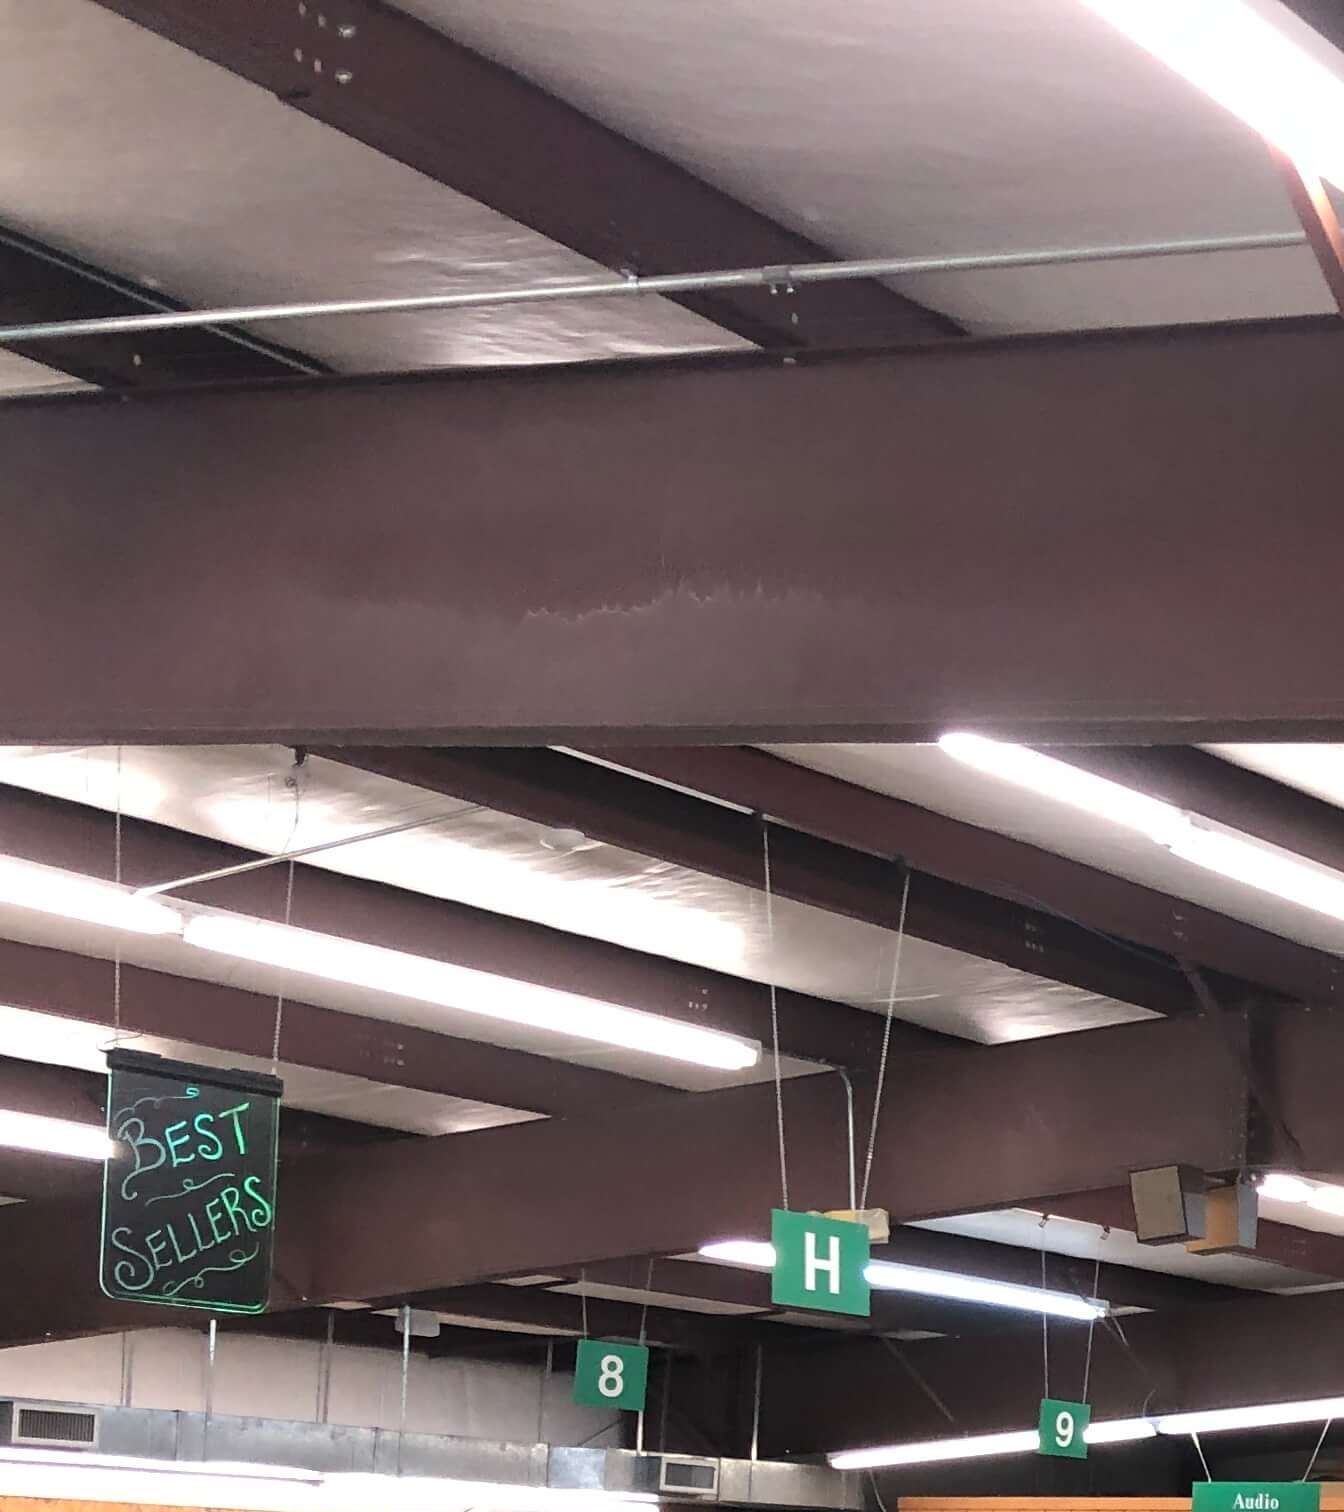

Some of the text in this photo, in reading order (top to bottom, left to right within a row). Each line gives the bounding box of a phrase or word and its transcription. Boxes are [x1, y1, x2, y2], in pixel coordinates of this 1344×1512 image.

[117, 1101, 250, 1201] BEST
[110, 1176, 273, 1291] SELLERS
[804, 1231, 841, 1295] H
[598, 1354, 624, 1398] 8
[1054, 1411, 1075, 1448] 9
[1232, 1492, 1280, 1510] Audio
